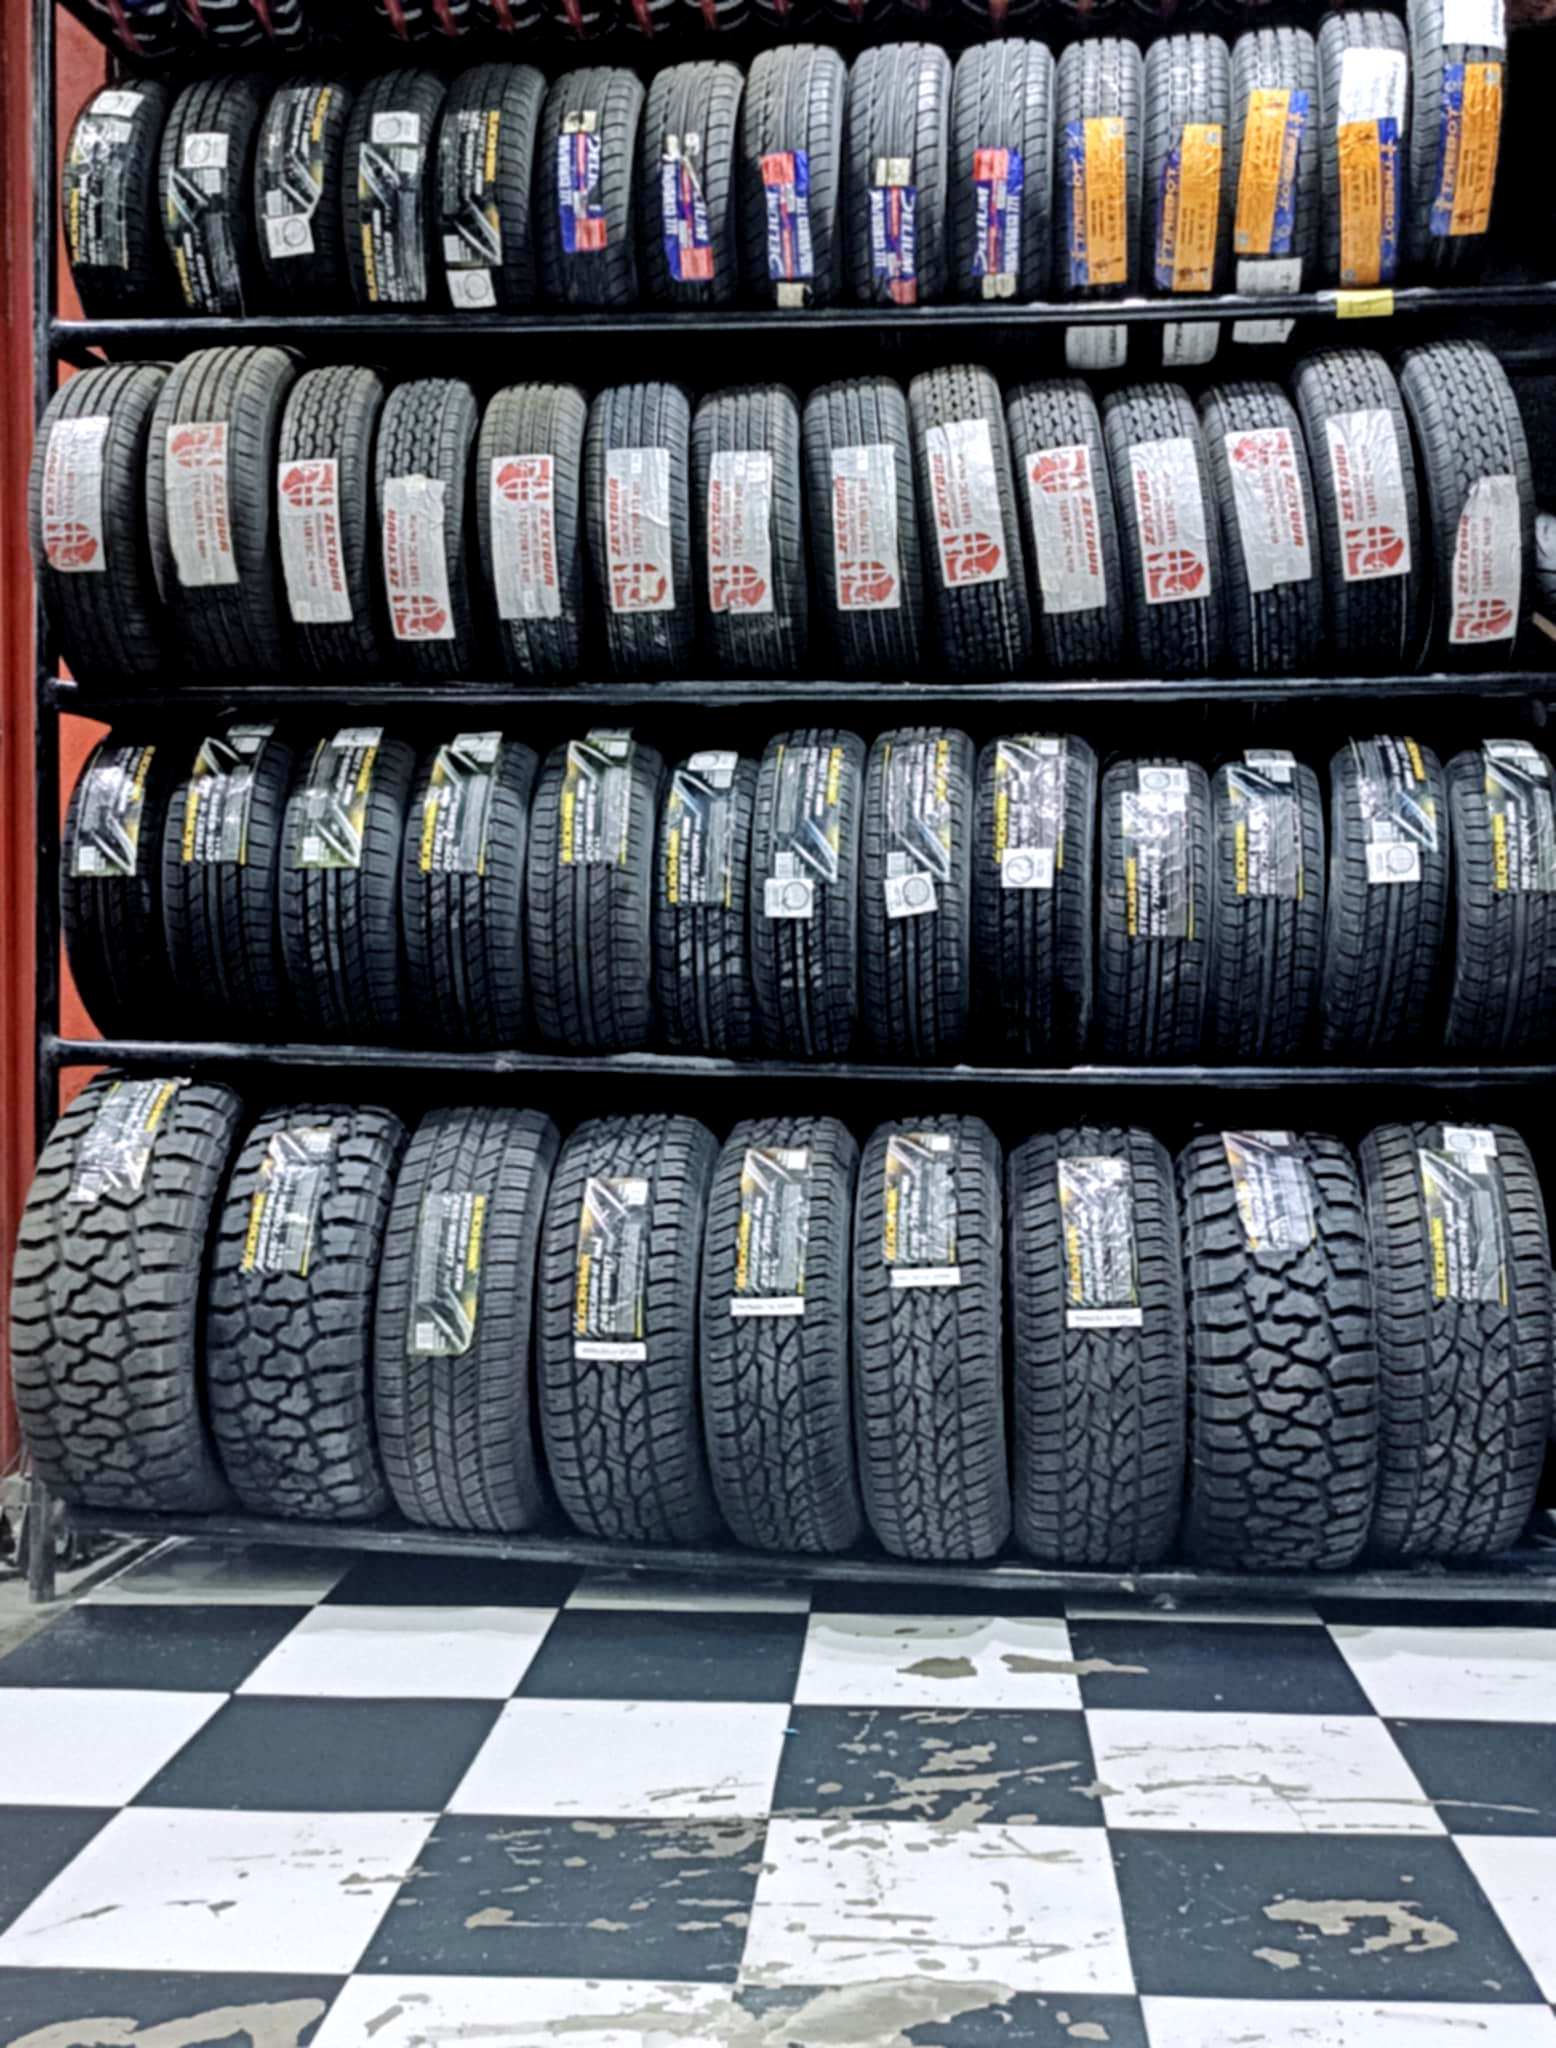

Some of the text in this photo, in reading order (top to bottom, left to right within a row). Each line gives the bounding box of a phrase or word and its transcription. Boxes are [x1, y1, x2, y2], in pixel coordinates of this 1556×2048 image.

[766, 191, 784, 275] DELIUM
[899, 188, 915, 273] DELIUM
[213, 474, 229, 553] ZEXTOUR
[384, 509, 399, 587] ZEXTOUR
[540, 508, 554, 586] ZEXTOUR
[608, 478, 620, 556] ZEXTOUR
[711, 480, 721, 558] ZEXTOUR
[834, 475, 848, 553] ZEXTOUR
[1081, 497, 1099, 576] ZEXTOUR
[324, 513, 343, 593] ZEXTOUR
